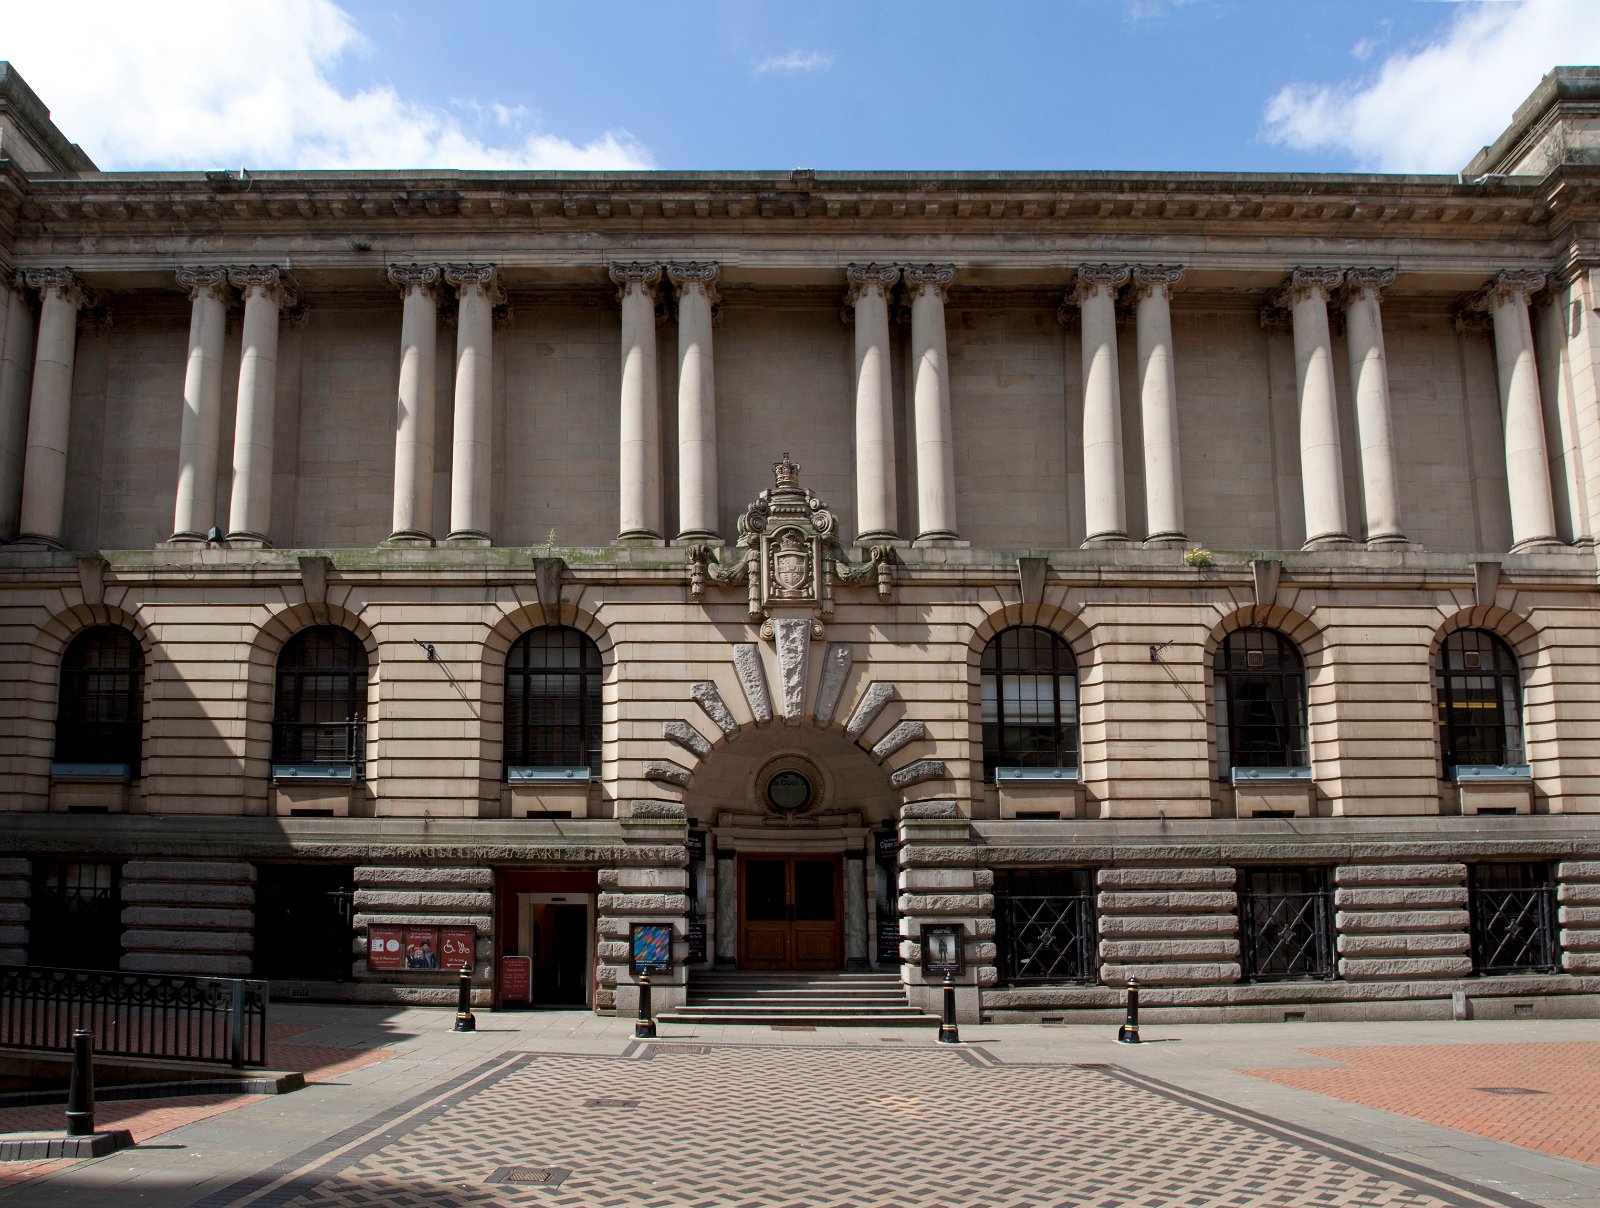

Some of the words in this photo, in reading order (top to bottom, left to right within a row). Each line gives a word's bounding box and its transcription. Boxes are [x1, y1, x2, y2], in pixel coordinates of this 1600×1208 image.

[408, 847, 489, 859] MUSEUM
[532, 848, 564, 860] ART
[582, 848, 664, 860] GALLERY
